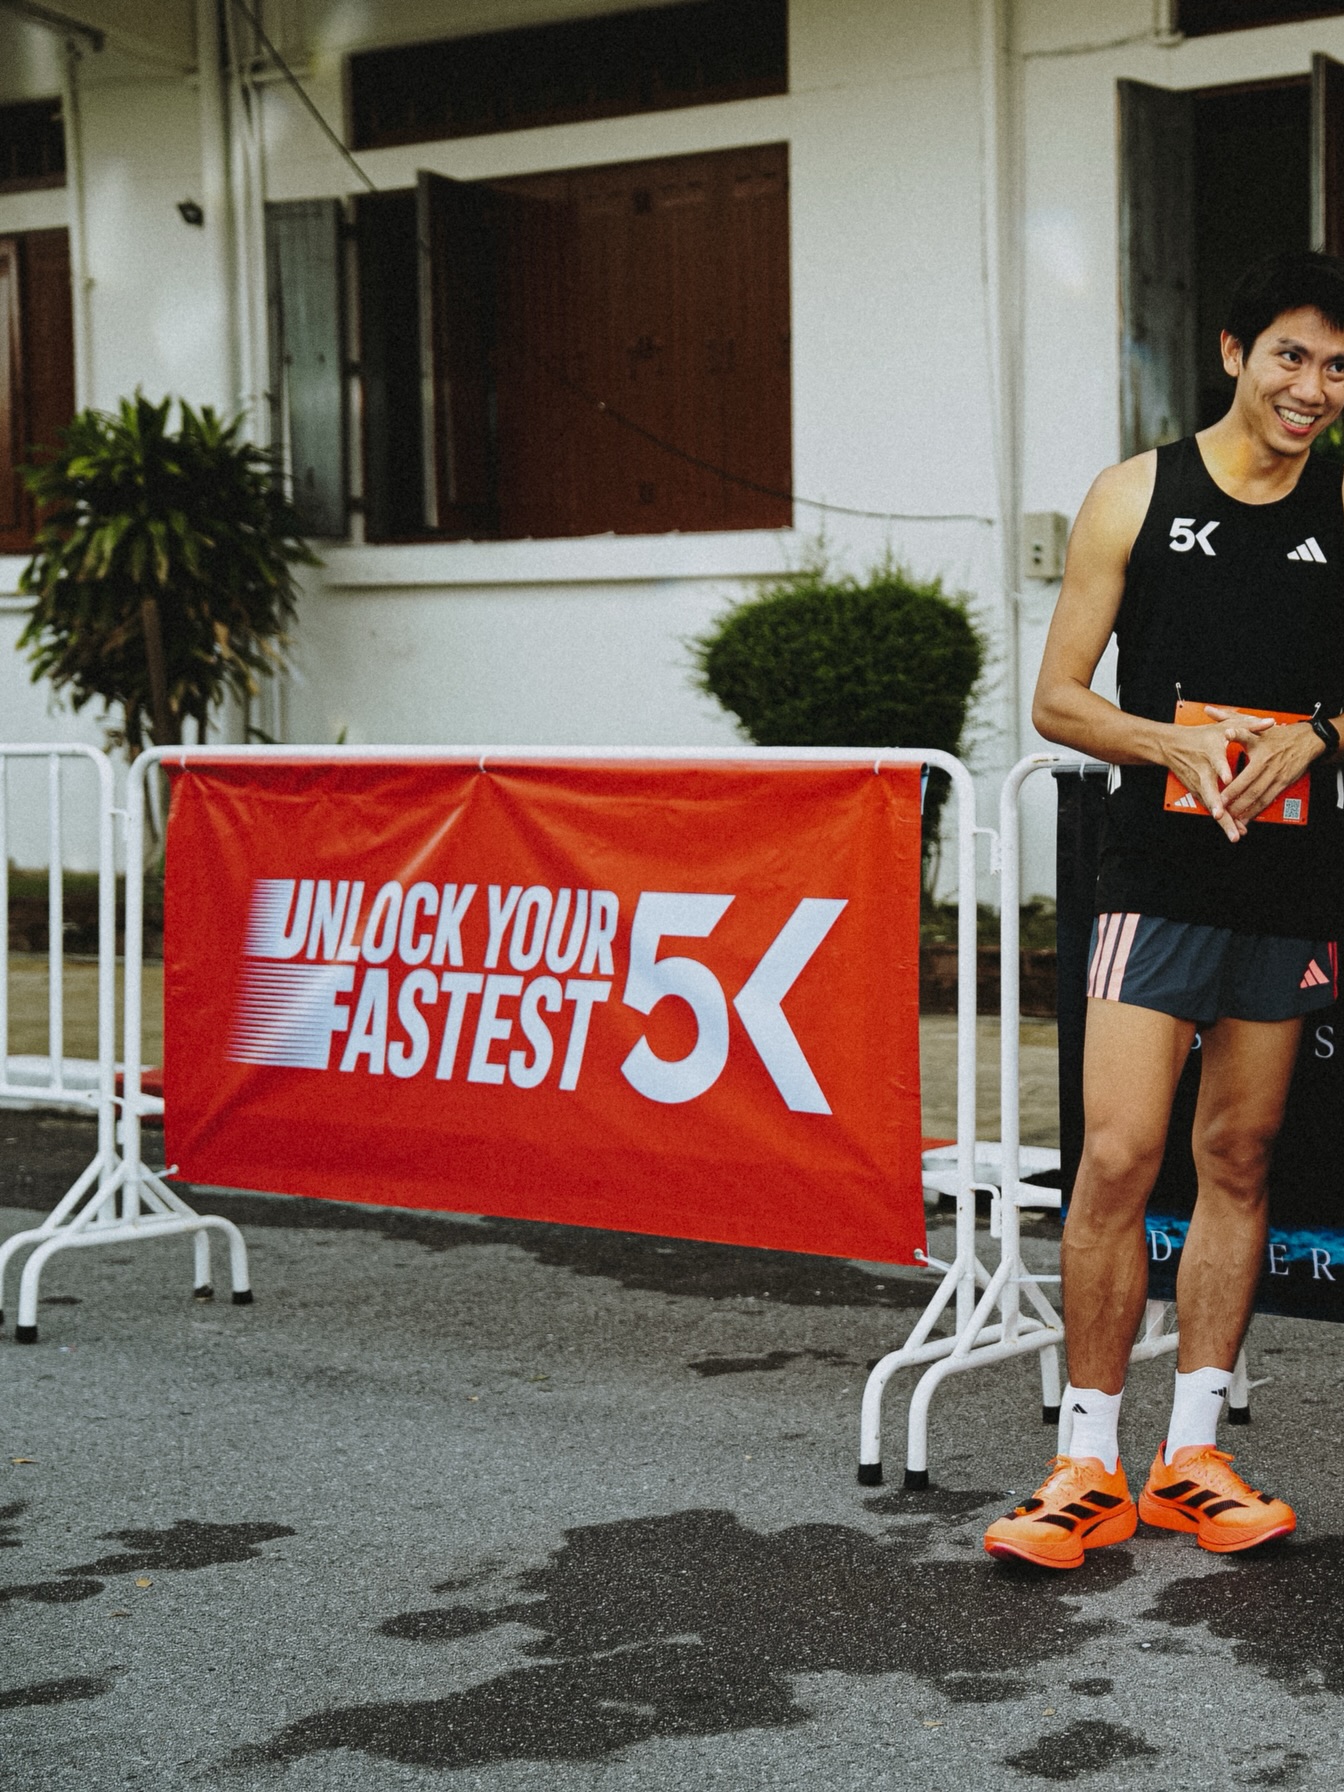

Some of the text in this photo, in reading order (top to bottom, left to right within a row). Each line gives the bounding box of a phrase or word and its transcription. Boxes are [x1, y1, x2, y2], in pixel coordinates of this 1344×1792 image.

[1168, 517, 1221, 557] 5K
[246, 878, 619, 975] UNLOCK YOUR
[236, 961, 612, 1092] FASTEST
[619, 890, 849, 1116] 5K
